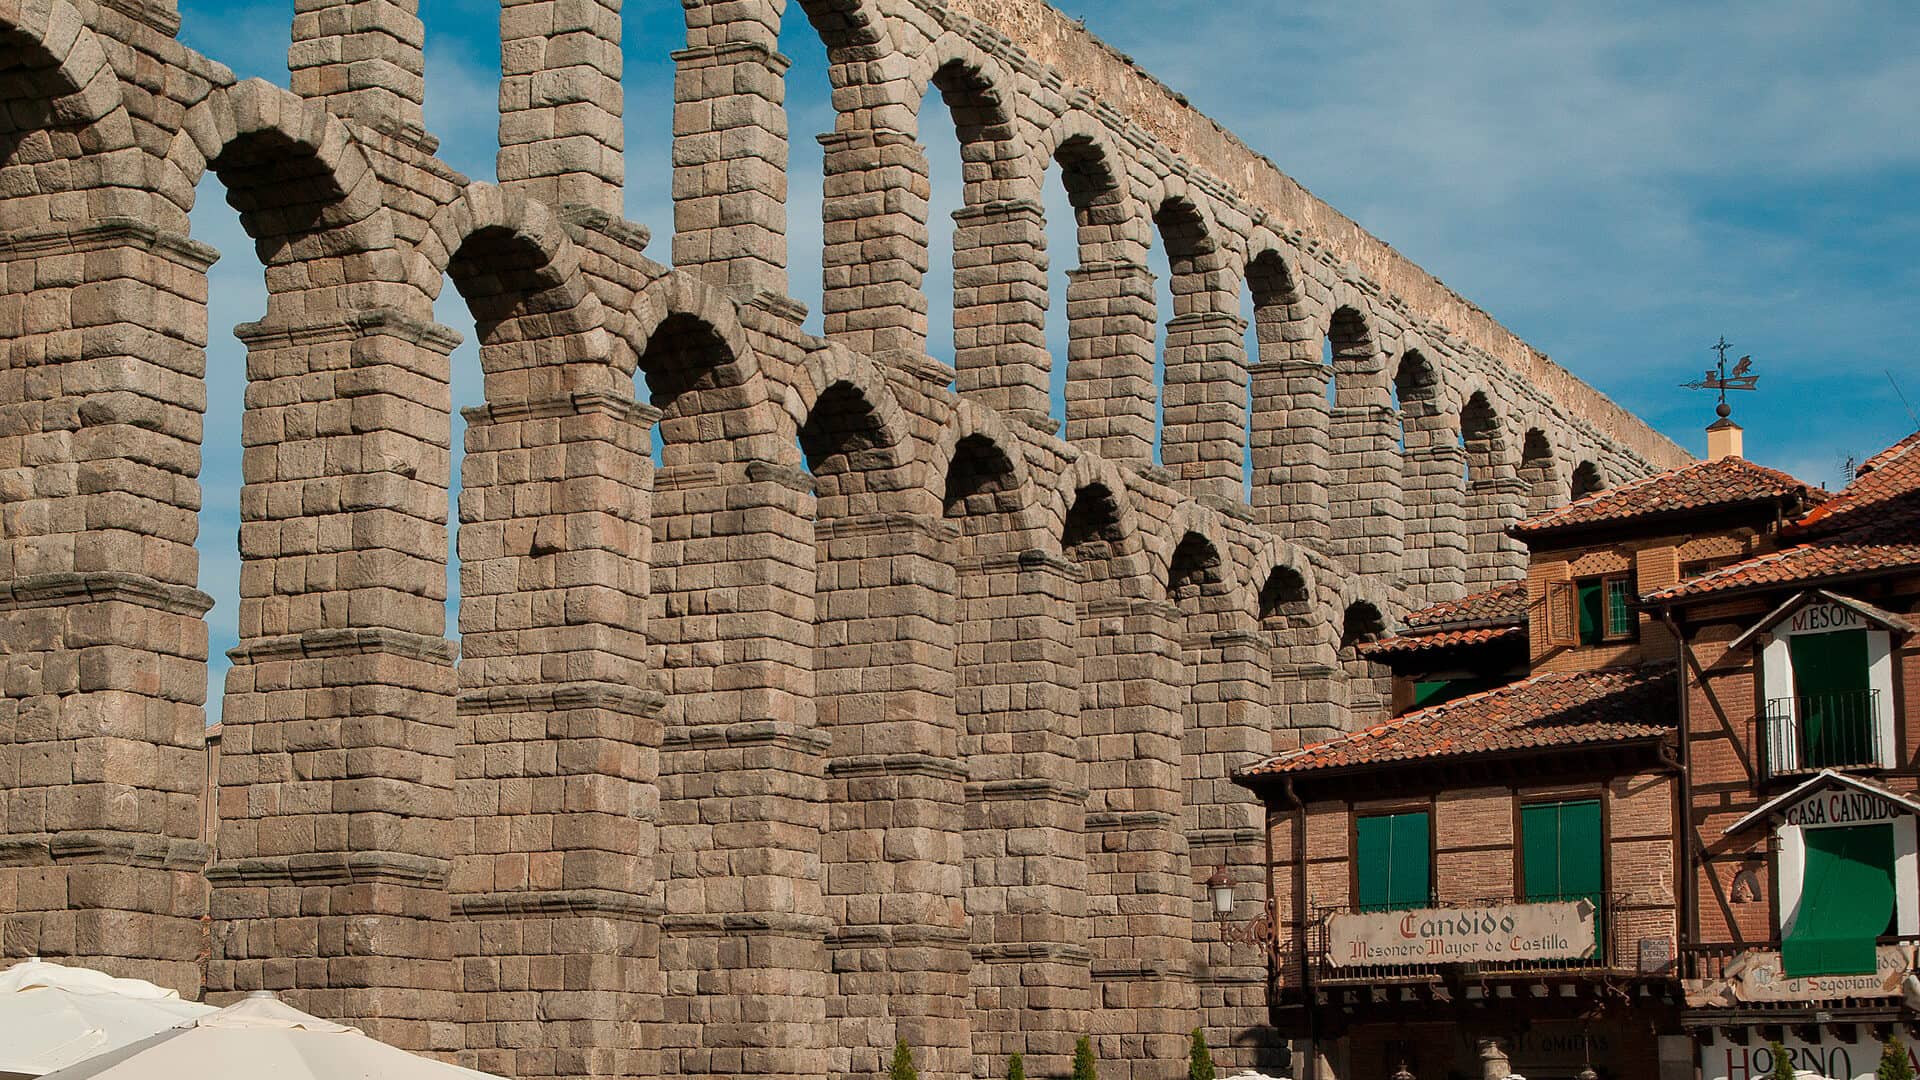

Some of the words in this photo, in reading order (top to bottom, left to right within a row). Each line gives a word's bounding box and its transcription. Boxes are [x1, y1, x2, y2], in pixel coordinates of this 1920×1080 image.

[1791, 604, 1857, 631] MESON
[1787, 798, 1827, 826] CASA
[1829, 794, 1900, 823] CANDIDO
[1400, 911, 1515, 939] Candido
[1350, 940, 1425, 960] Mesonero
[1427, 938, 1479, 961] Mayor
[1485, 939, 1502, 953] de
[1510, 934, 1569, 951] Castilla
[1788, 976, 1800, 993] el
[1807, 976, 1882, 996] Segoviano
[1726, 1046, 1852, 1080] HORNO
